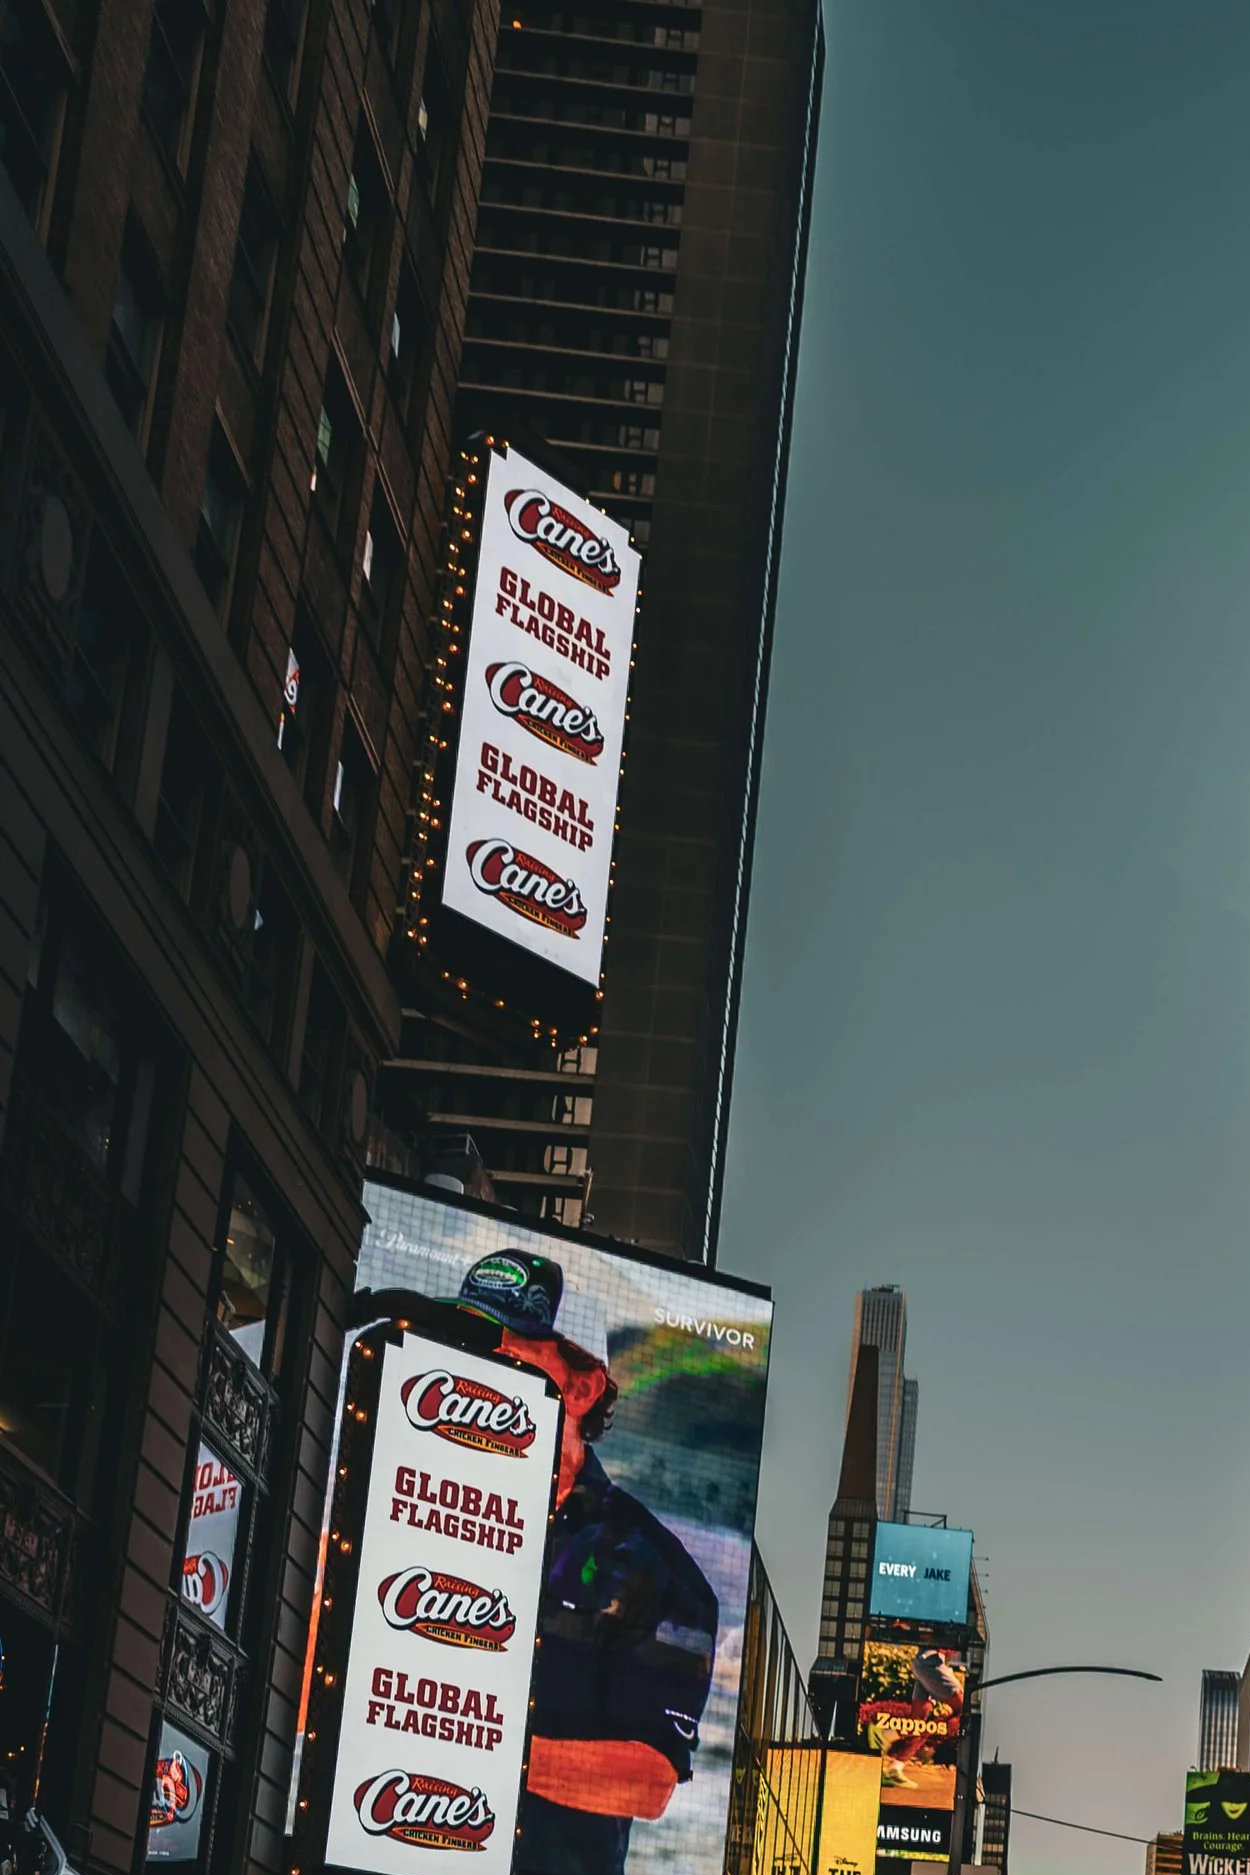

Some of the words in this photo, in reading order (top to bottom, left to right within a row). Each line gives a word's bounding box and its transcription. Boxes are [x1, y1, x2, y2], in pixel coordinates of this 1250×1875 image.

[509, 489, 620, 575] Cane's
[495, 592, 611, 681] FLAGSHIP
[500, 566, 611, 662] GLOBAL
[490, 662, 604, 742] Cane's
[476, 769, 594, 852] FLAGSHIP
[481, 741, 595, 832] GLOBAL
[470, 838, 586, 916] Cane's
[654, 1307, 755, 1351] SURVIVOR
[405, 1370, 536, 1436] Cane's
[455, 1379, 501, 1404] Raising
[449, 1428, 484, 1445] CHICKEN
[390, 1497, 524, 1555] FLAGSHIP
[394, 1465, 525, 1530] GLOBAL
[383, 1567, 517, 1628] Cane's
[434, 1575, 480, 1598] Raising
[879, 1561, 917, 1578] EVERY
[923, 1567, 951, 1582] JAKE
[426, 1626, 462, 1642] CHICKEN
[464, 1634, 500, 1651] FINGERS
[366, 1699, 503, 1751] FLAGSHIP
[371, 1666, 504, 1726] GLOBAL
[876, 1711, 949, 1737] Zappos
[359, 1769, 496, 1832] Cane's
[411, 1777, 458, 1797] Raising
[402, 1828, 440, 1844] CHICKEN
[442, 1834, 478, 1850] FINGERS
[834, 1855, 859, 1869] Disney
